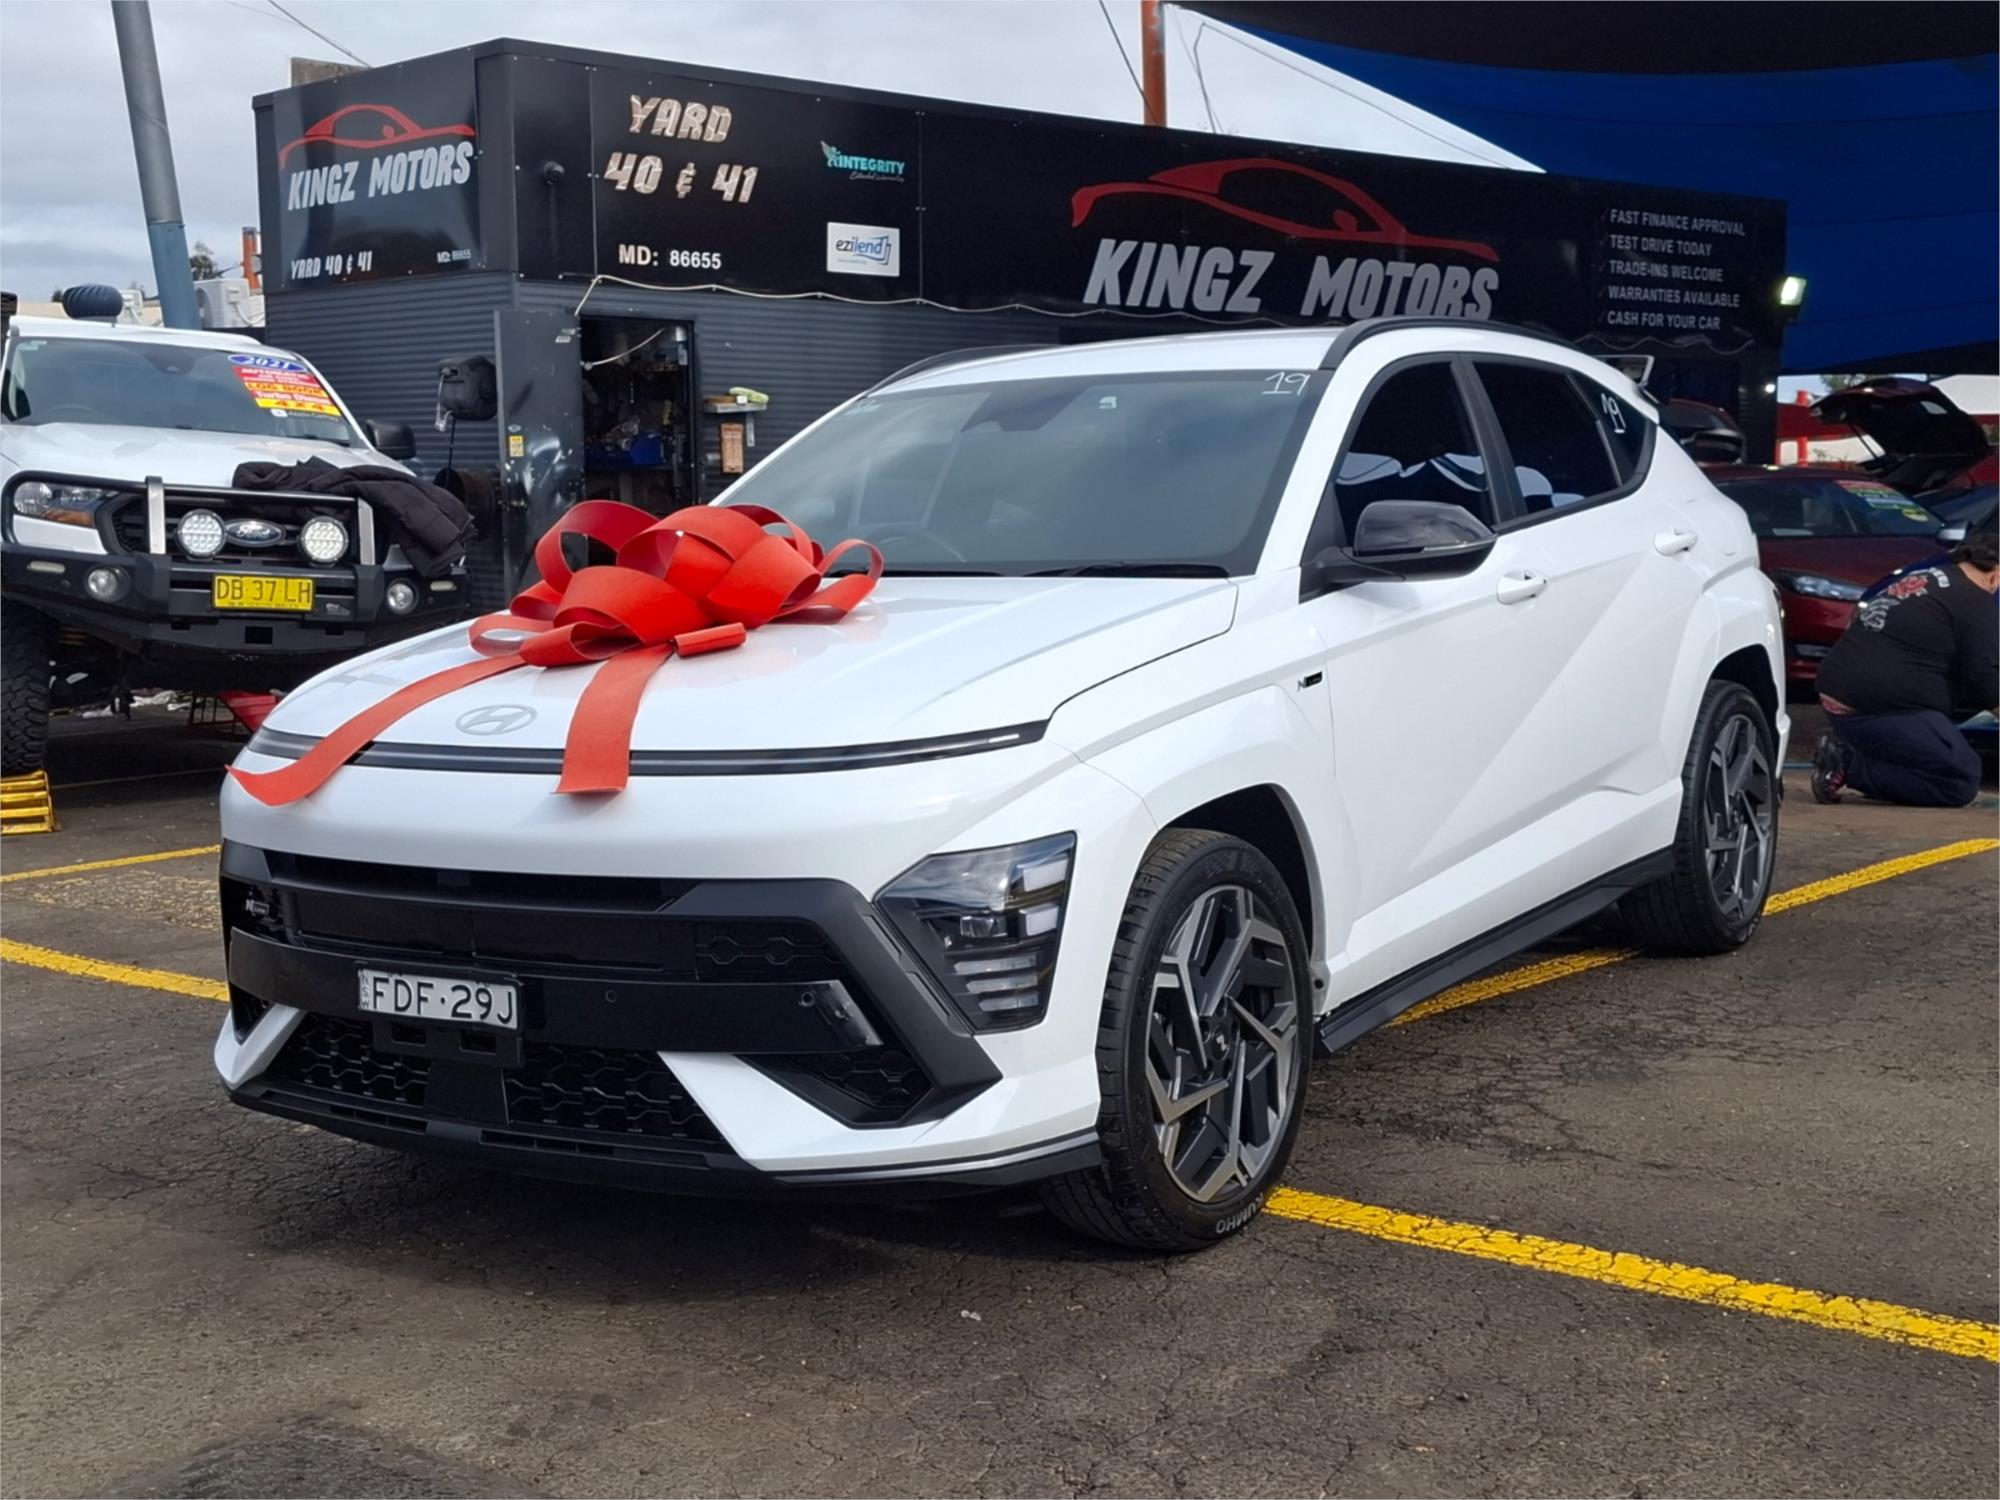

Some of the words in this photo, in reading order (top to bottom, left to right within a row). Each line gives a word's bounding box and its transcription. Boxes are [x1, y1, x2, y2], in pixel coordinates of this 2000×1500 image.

[629, 94, 733, 143] YARD
[287, 161, 360, 211] KINGZ
[367, 141, 474, 198] MOTORS
[839, 154, 905, 175] INTEGRITY
[603, 152, 663, 195] 40
[711, 164, 759, 203] 41
[1610, 208, 1641, 225] FAST
[1642, 211, 1690, 230] FINANCE
[1691, 217, 1746, 237] APPROVAL
[618, 243, 659, 267] MD:
[669, 249, 722, 270] 86655
[1609, 234, 1640, 250] TEST
[1641, 236, 1675, 254] DRIVE
[1677, 240, 1713, 257] TODAY
[290, 257, 321, 280] YARD
[324, 253, 343, 276] 40
[357, 251, 374, 272] 41
[1609, 259, 1669, 278] TRADE-INS
[1671, 265, 1724, 283] WELCOME
[1082, 238, 1276, 314] KINGZ
[1300, 255, 1500, 321] MOTORS
[1608, 285, 1681, 304] WARRANTIES
[1683, 290, 1741, 308] AVAILABLE
[1607, 310, 1640, 327] CASH
[1641, 312, 1665, 328] FOR
[1666, 314, 1697, 330] YOUR
[1697, 315, 1721, 331] CAR
[245, 356, 291, 370] 2021
[1262, 371, 1311, 396] 19
[236, 523, 271, 540] Ford
